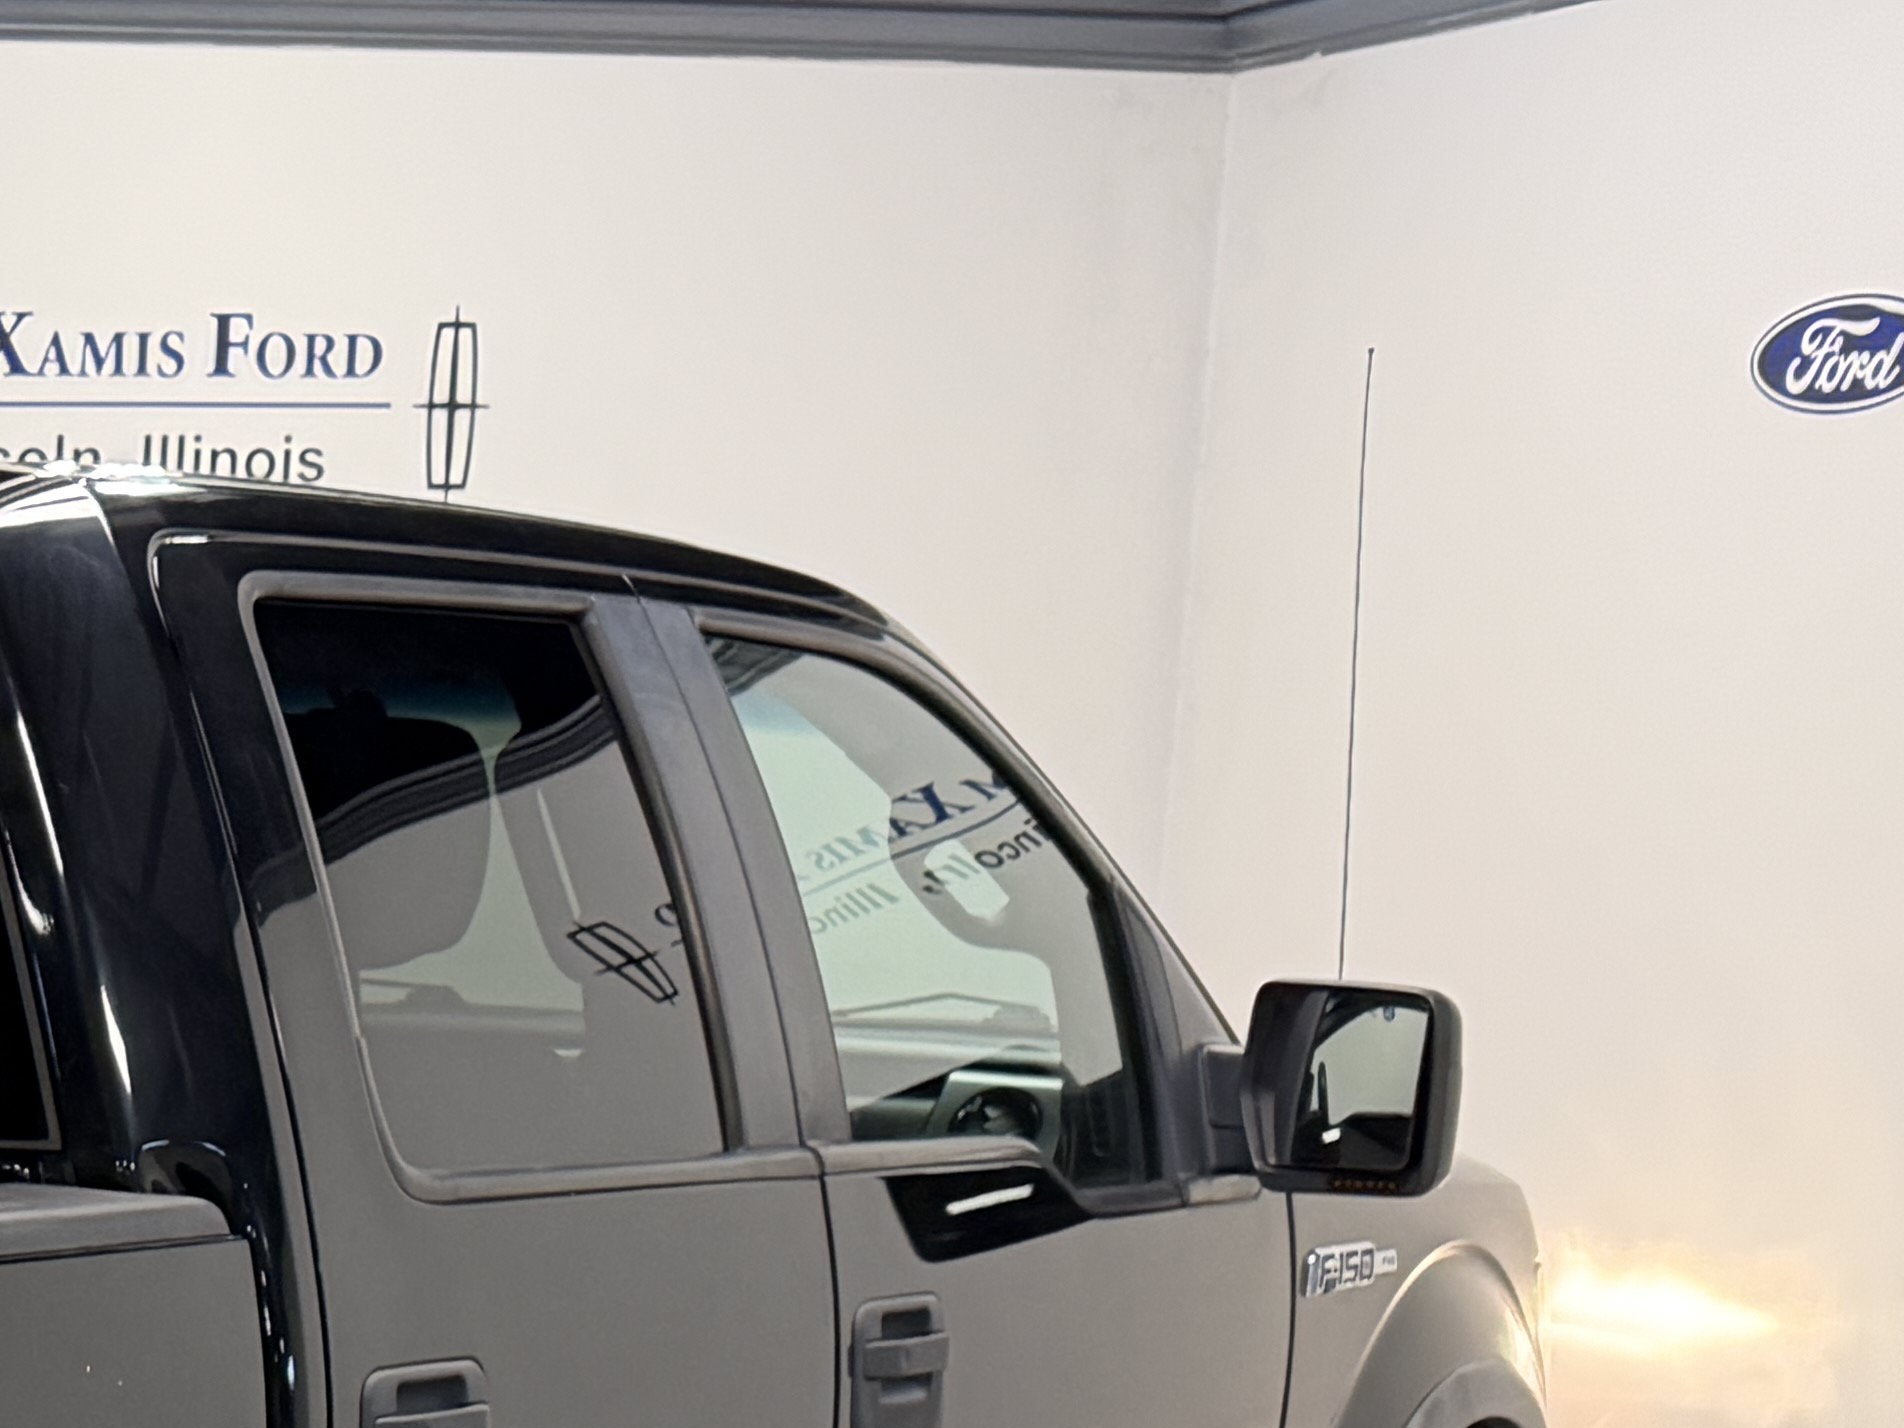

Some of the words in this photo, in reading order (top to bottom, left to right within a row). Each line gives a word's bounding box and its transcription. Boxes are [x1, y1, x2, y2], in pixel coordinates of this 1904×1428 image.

[206, 312, 385, 380] FORD
[1785, 316, 1904, 395] Ford
[143, 433, 326, 483] Illinois
[1318, 1247, 1376, 1294] F-150
